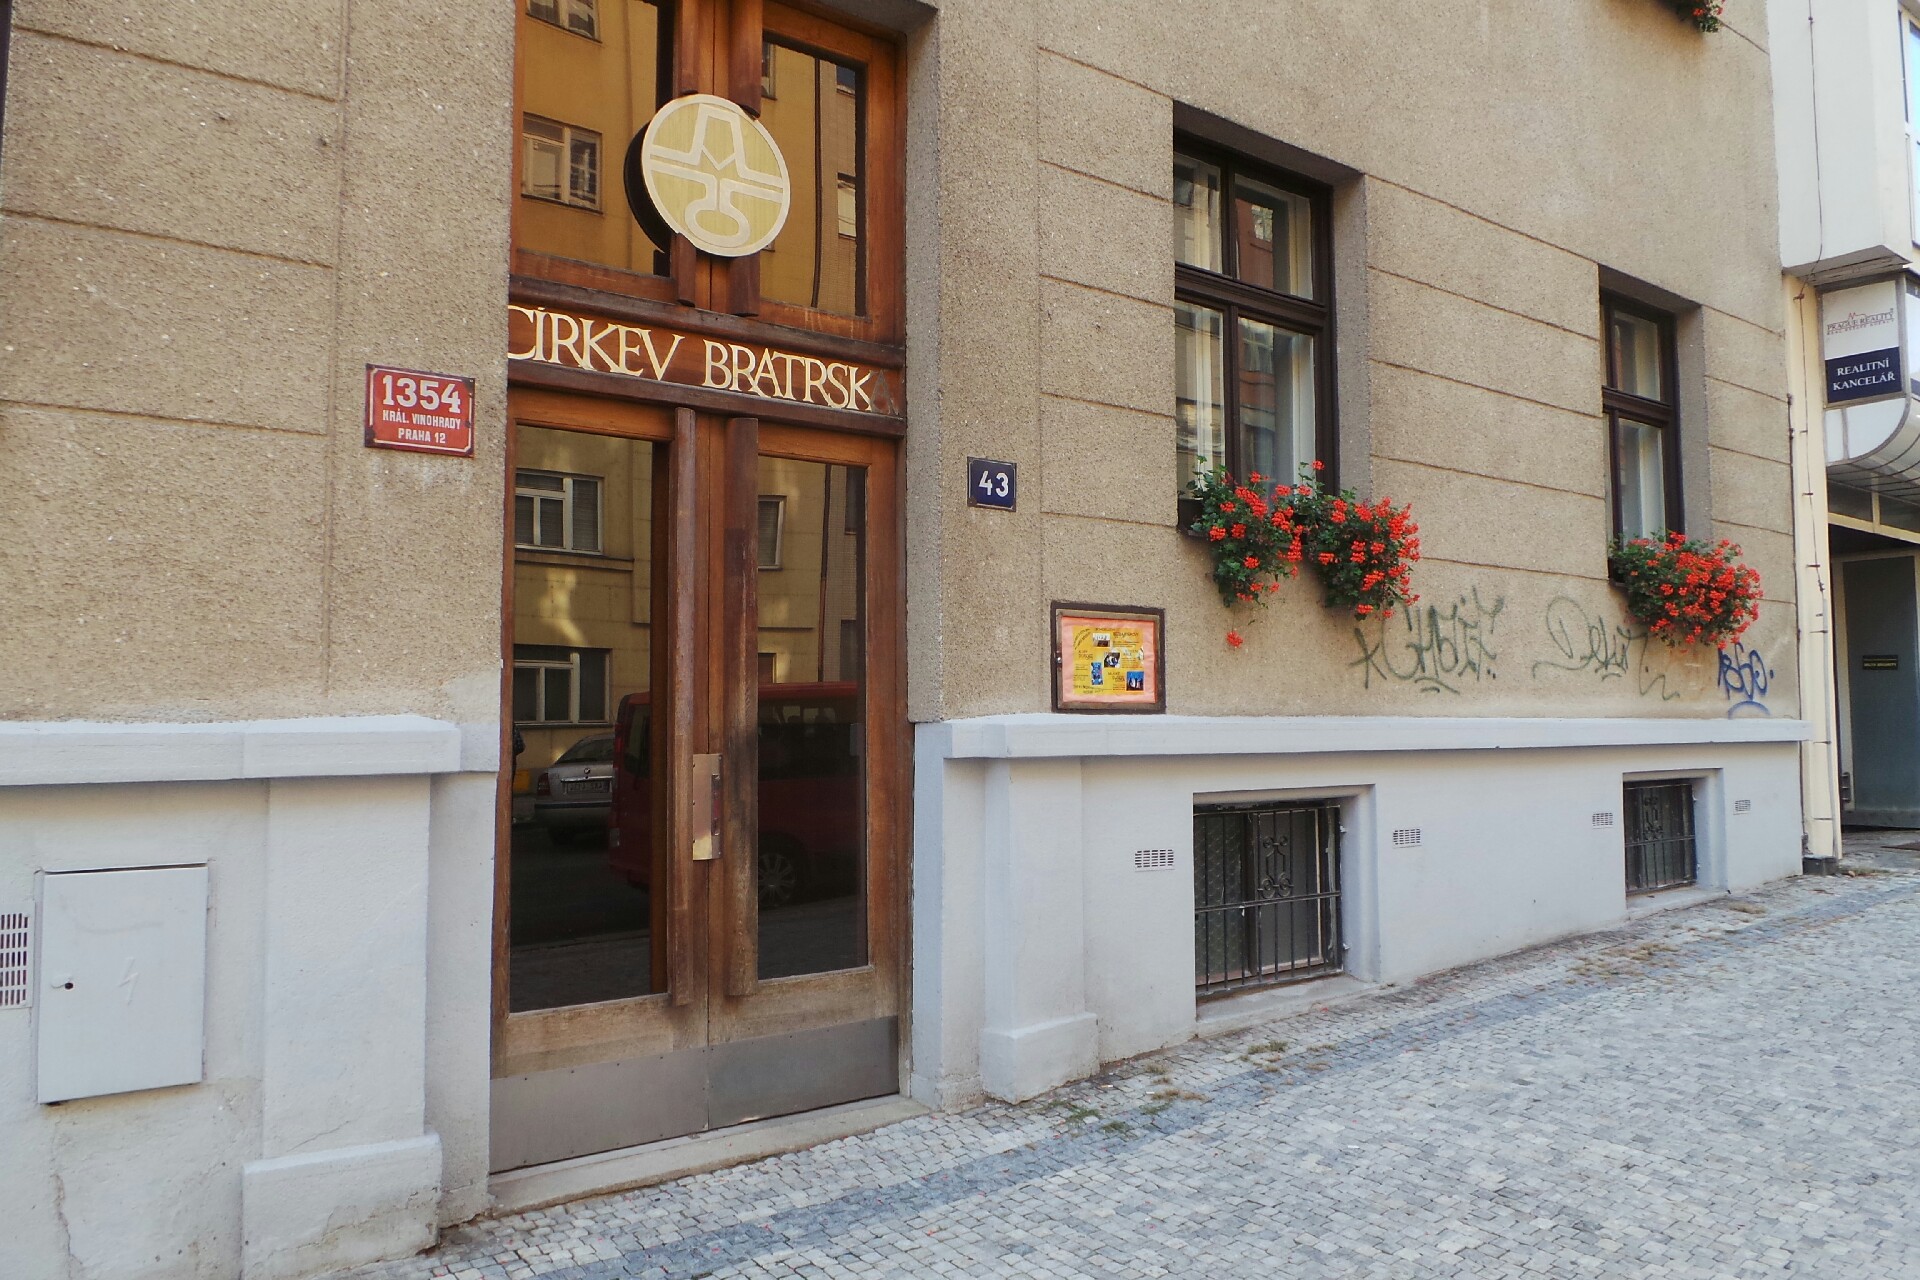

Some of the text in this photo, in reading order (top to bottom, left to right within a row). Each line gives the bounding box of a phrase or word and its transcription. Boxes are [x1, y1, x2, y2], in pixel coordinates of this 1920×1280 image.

[1827, 318, 1857, 331] PRAGUE
[1837, 358, 1889, 376] REALITNÍ
[1833, 371, 1895, 391] KANCELÁŘ
[382, 374, 461, 413] 1354
[382, 408, 461, 430] KRÁL. VINOHRADY
[398, 427, 446, 443] PRAHA 12
[978, 470, 1009, 498] 43
